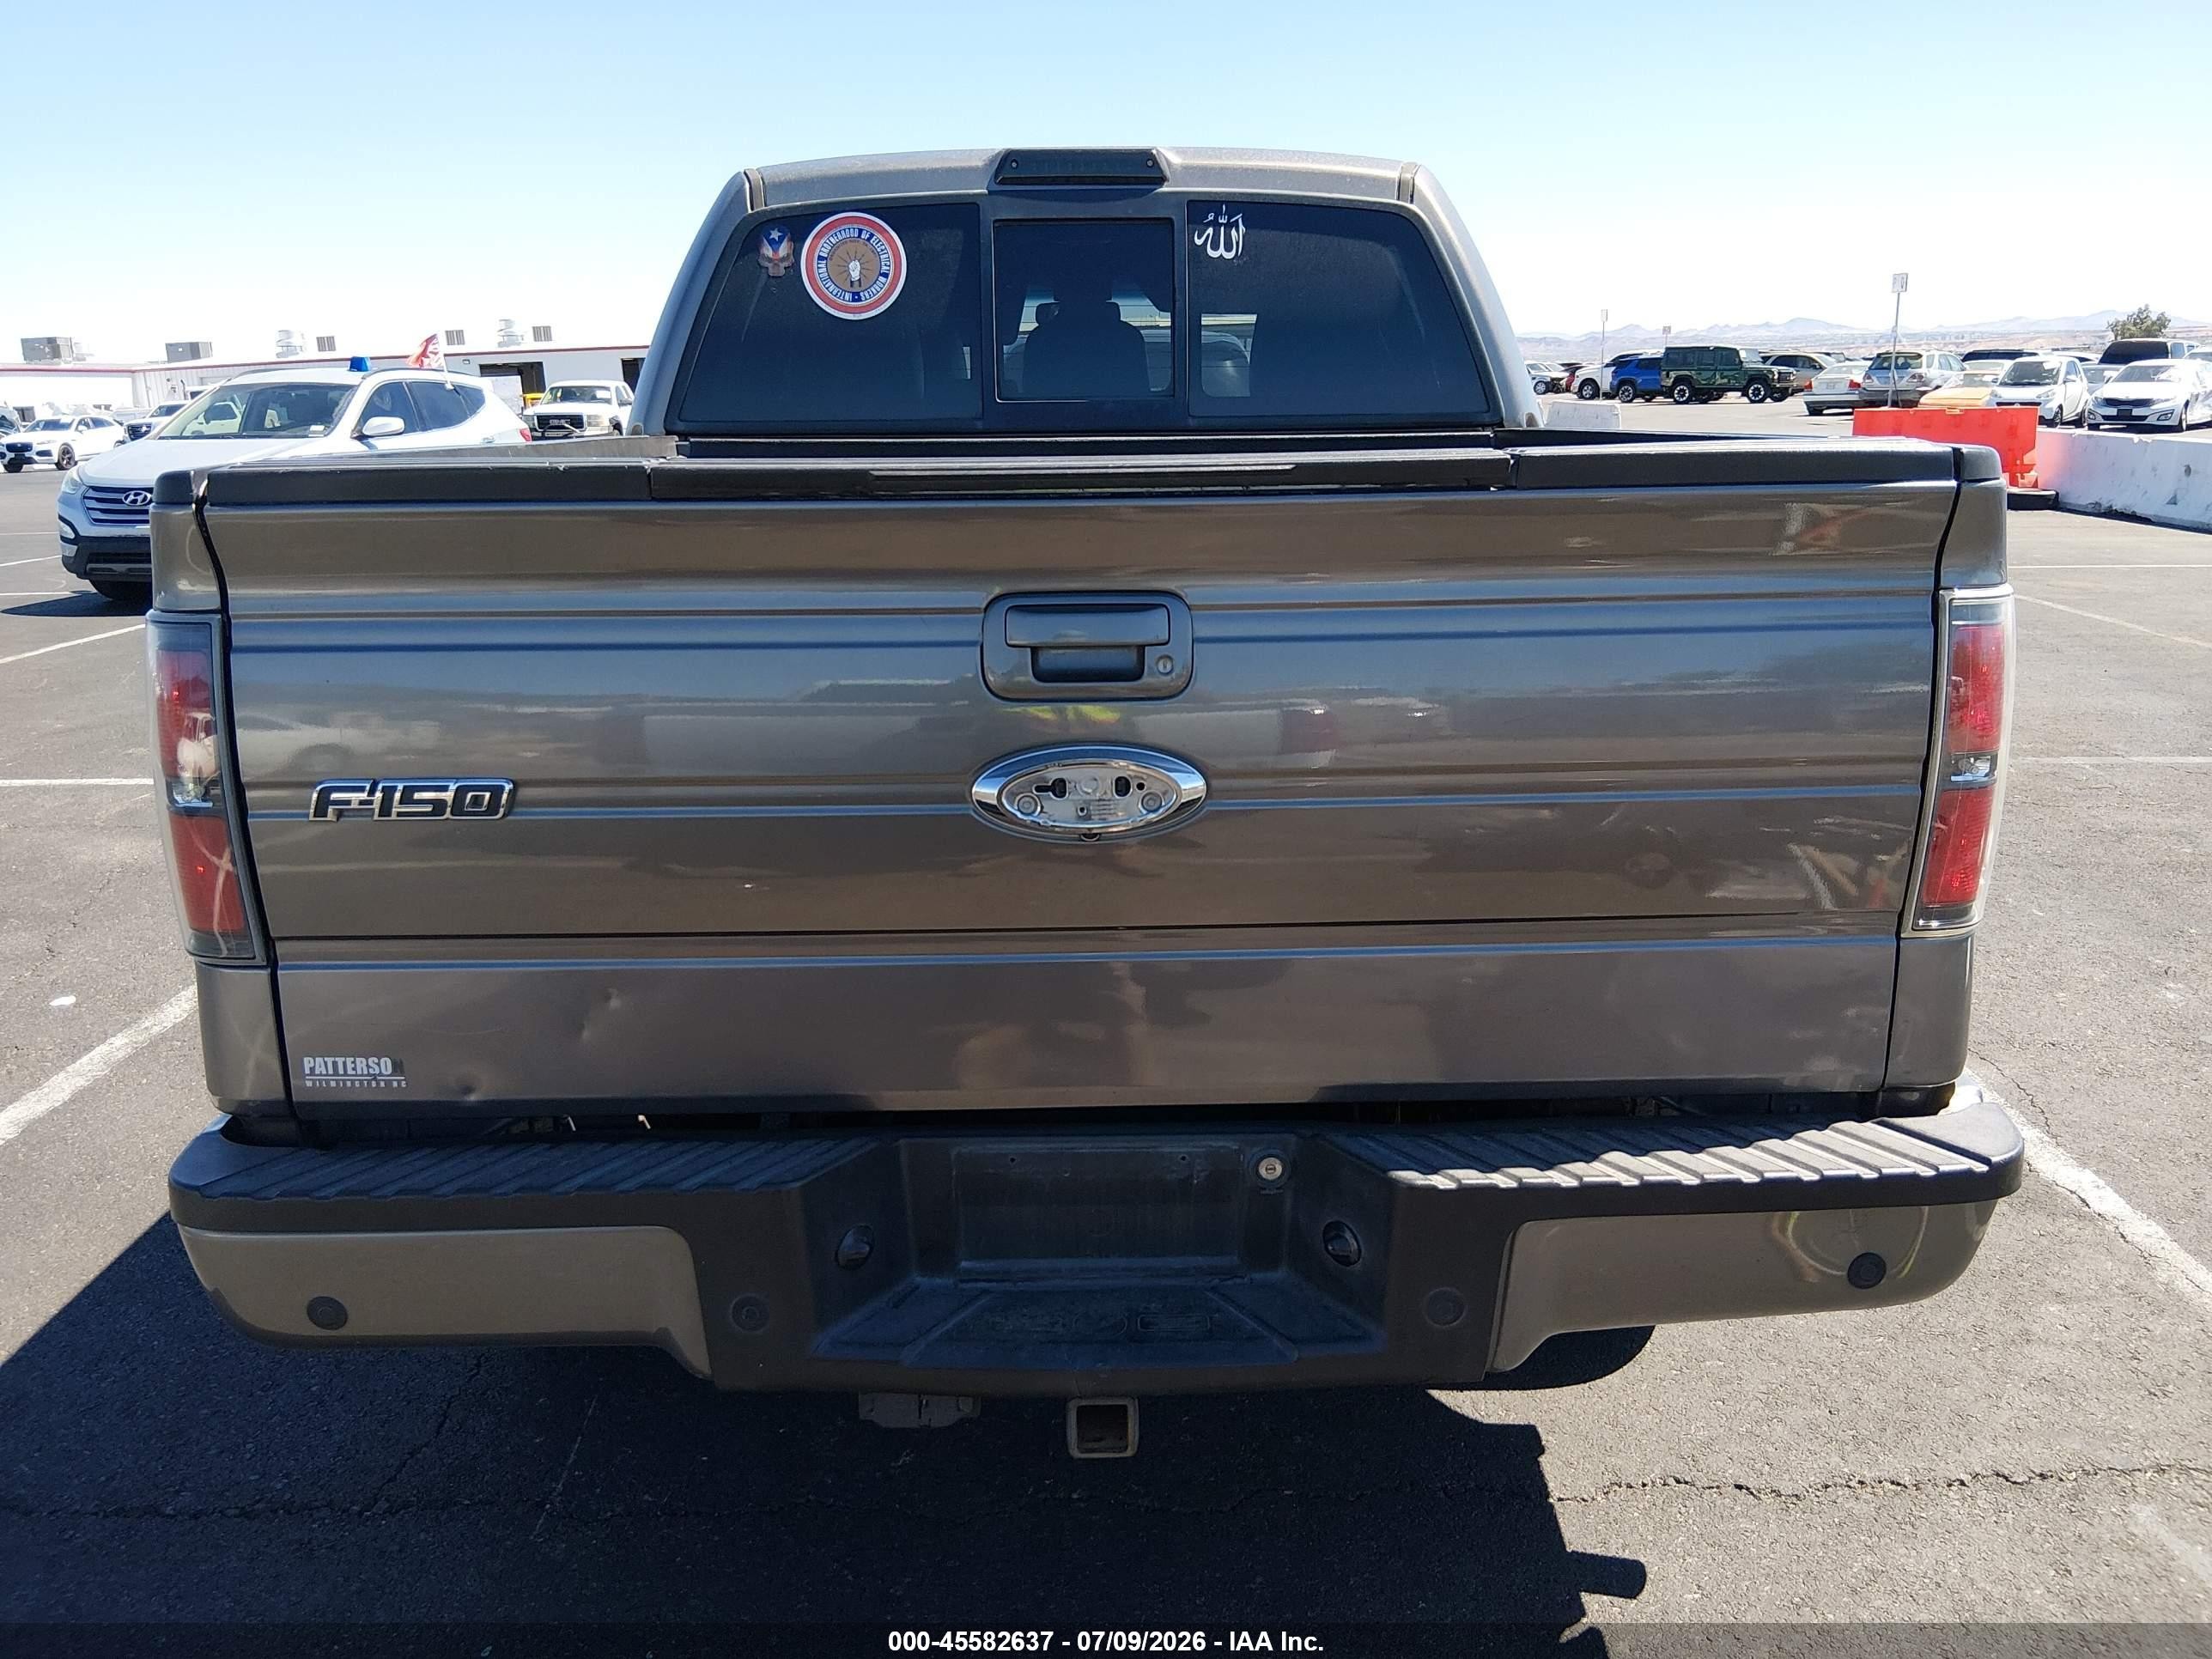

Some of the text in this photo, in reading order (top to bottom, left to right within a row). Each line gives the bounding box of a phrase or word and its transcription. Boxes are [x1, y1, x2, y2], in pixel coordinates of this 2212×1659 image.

[820, 228, 859, 257] BROTHERHOOD
[861, 231, 871, 240] OF
[870, 236, 890, 274] ELECTRICAL
[817, 260, 853, 301] INTERNATIONAL
[860, 276, 888, 301] WORKERS
